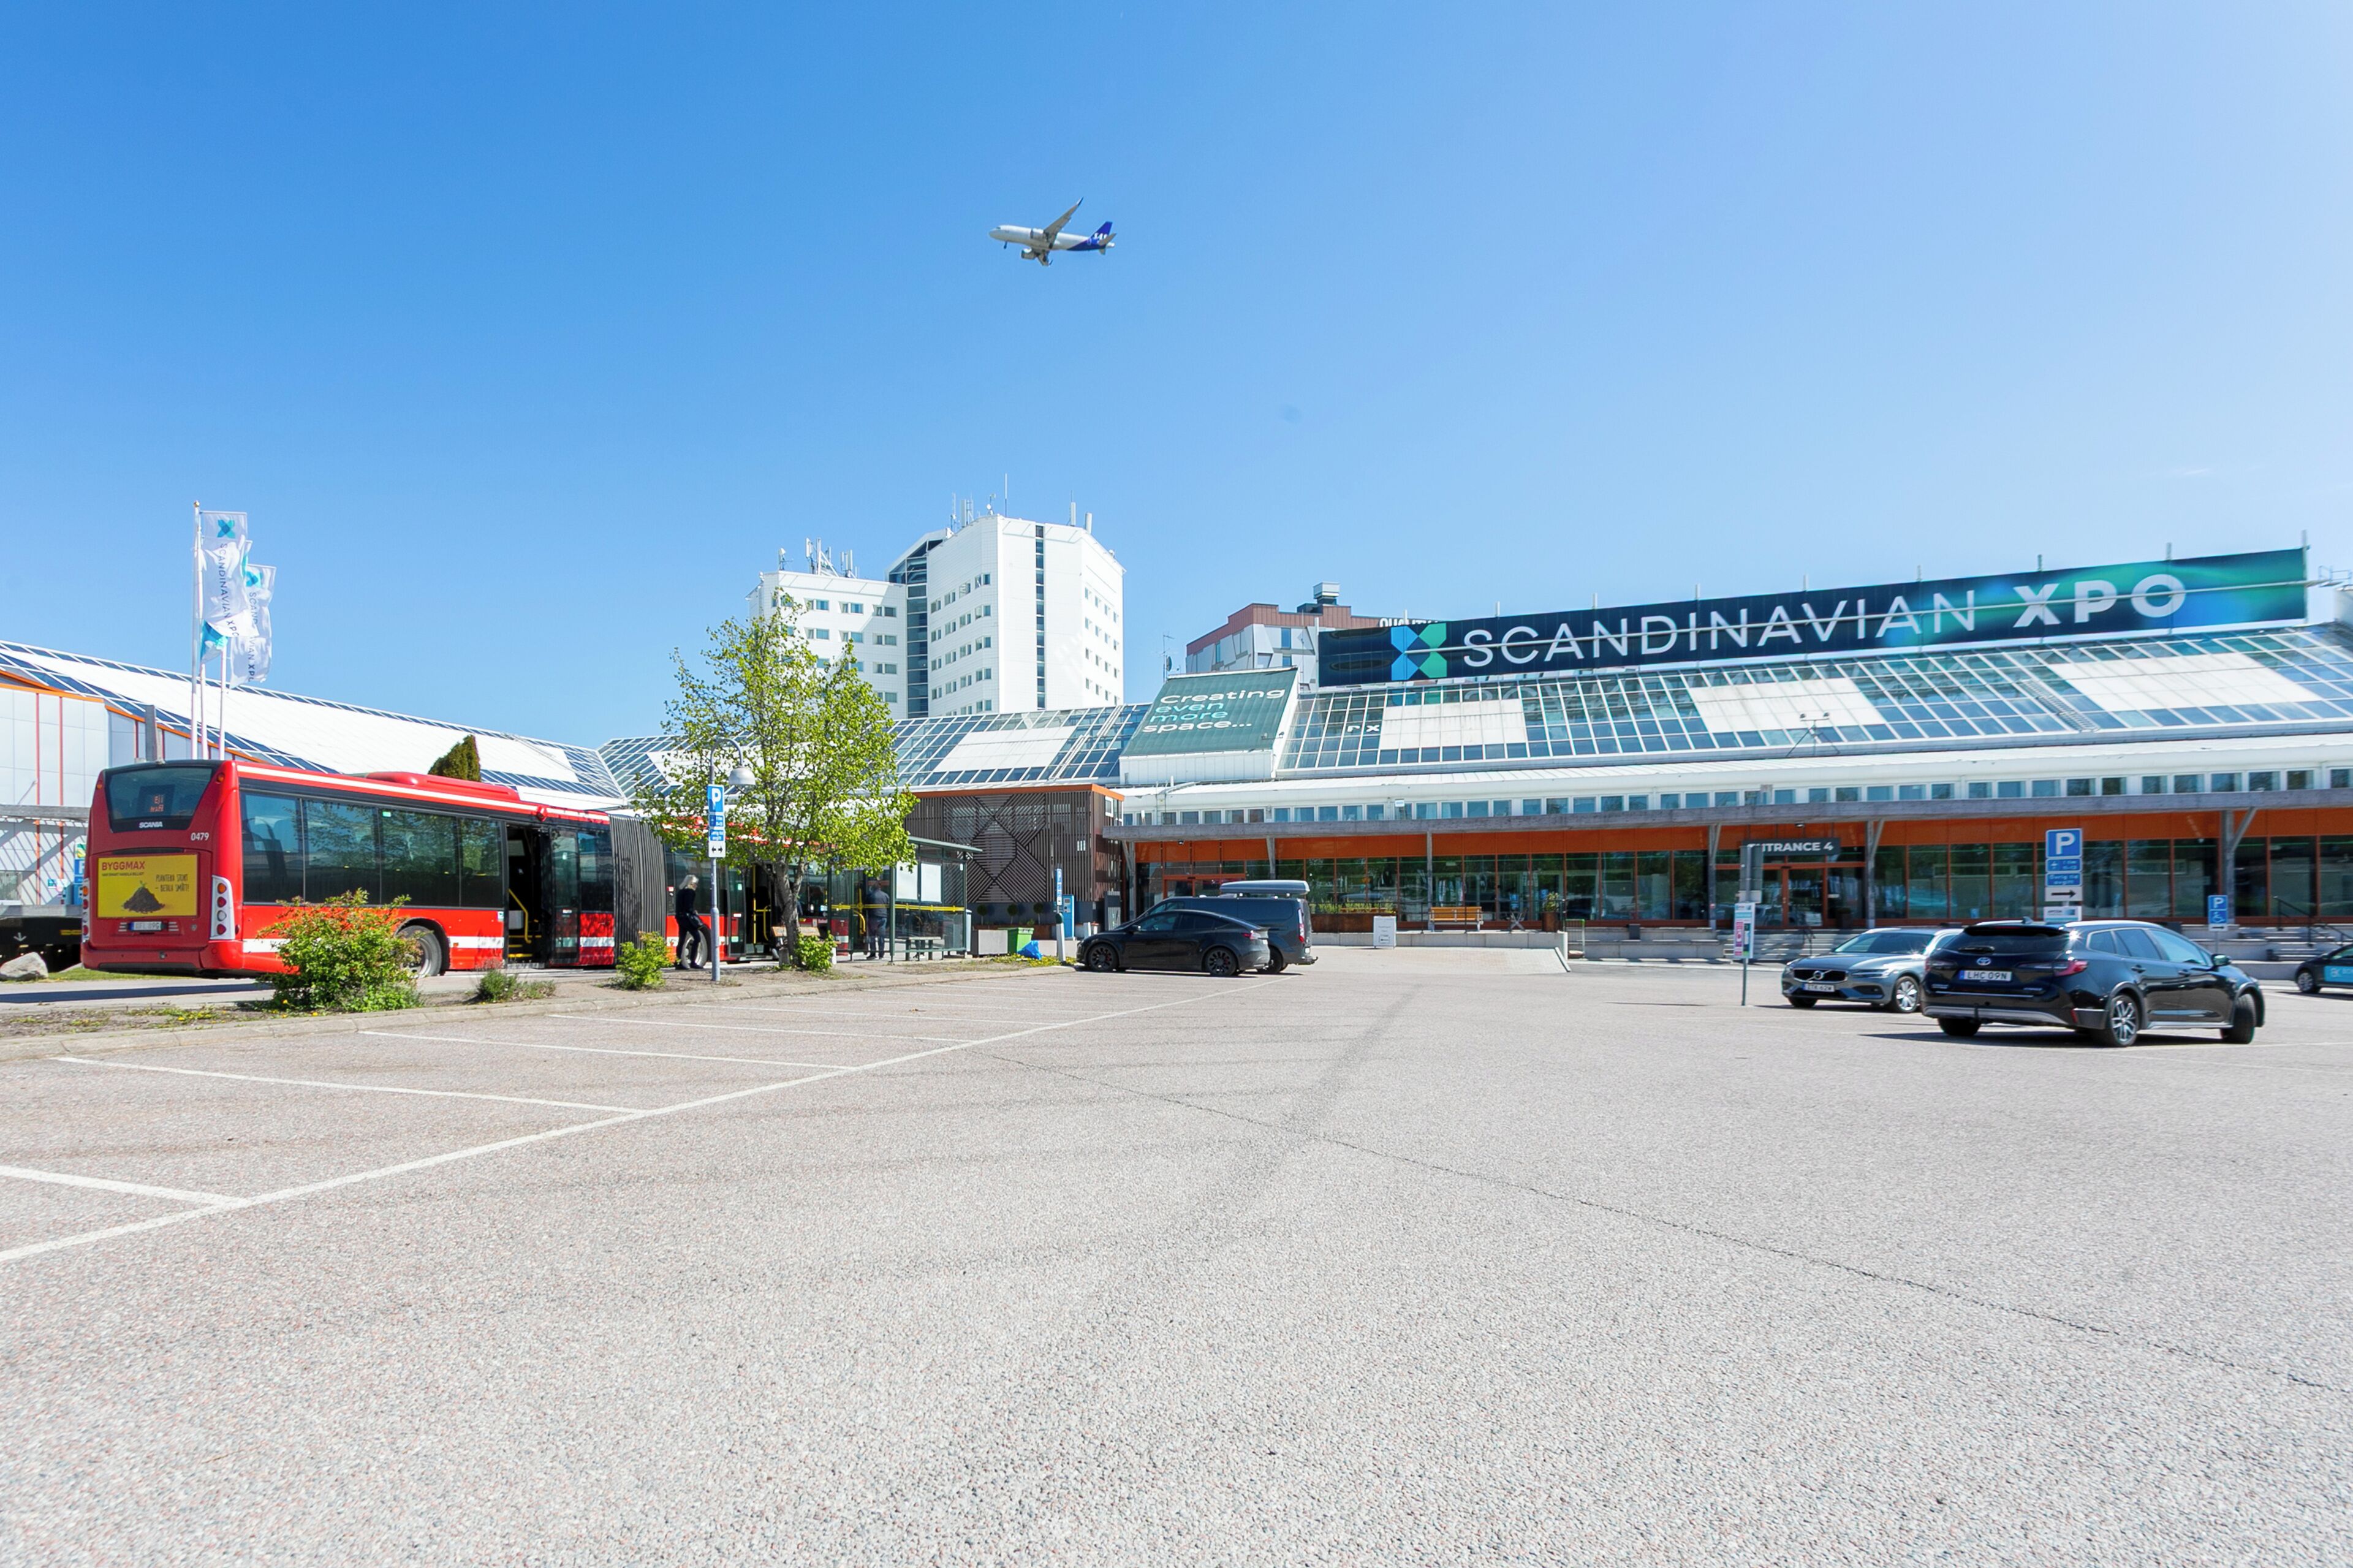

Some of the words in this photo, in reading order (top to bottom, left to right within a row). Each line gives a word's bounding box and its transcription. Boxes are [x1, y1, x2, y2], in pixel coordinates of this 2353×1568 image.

[1463, 590, 1974, 667] SCANDINAVIAN
[2012, 574, 2186, 628] XPO
[1161, 689, 1286, 703] Creating
[1156, 702, 1224, 713] even
[1150, 711, 1228, 722] more
[1143, 721, 1252, 733] space...
[711, 787, 721, 810] P
[191, 832, 210, 841] 0479
[1823, 841, 1834, 850] 4
[2056, 832, 2075, 855] P
[102, 862, 145, 870] BYGGMAX
[2213, 898, 2224, 908] P
